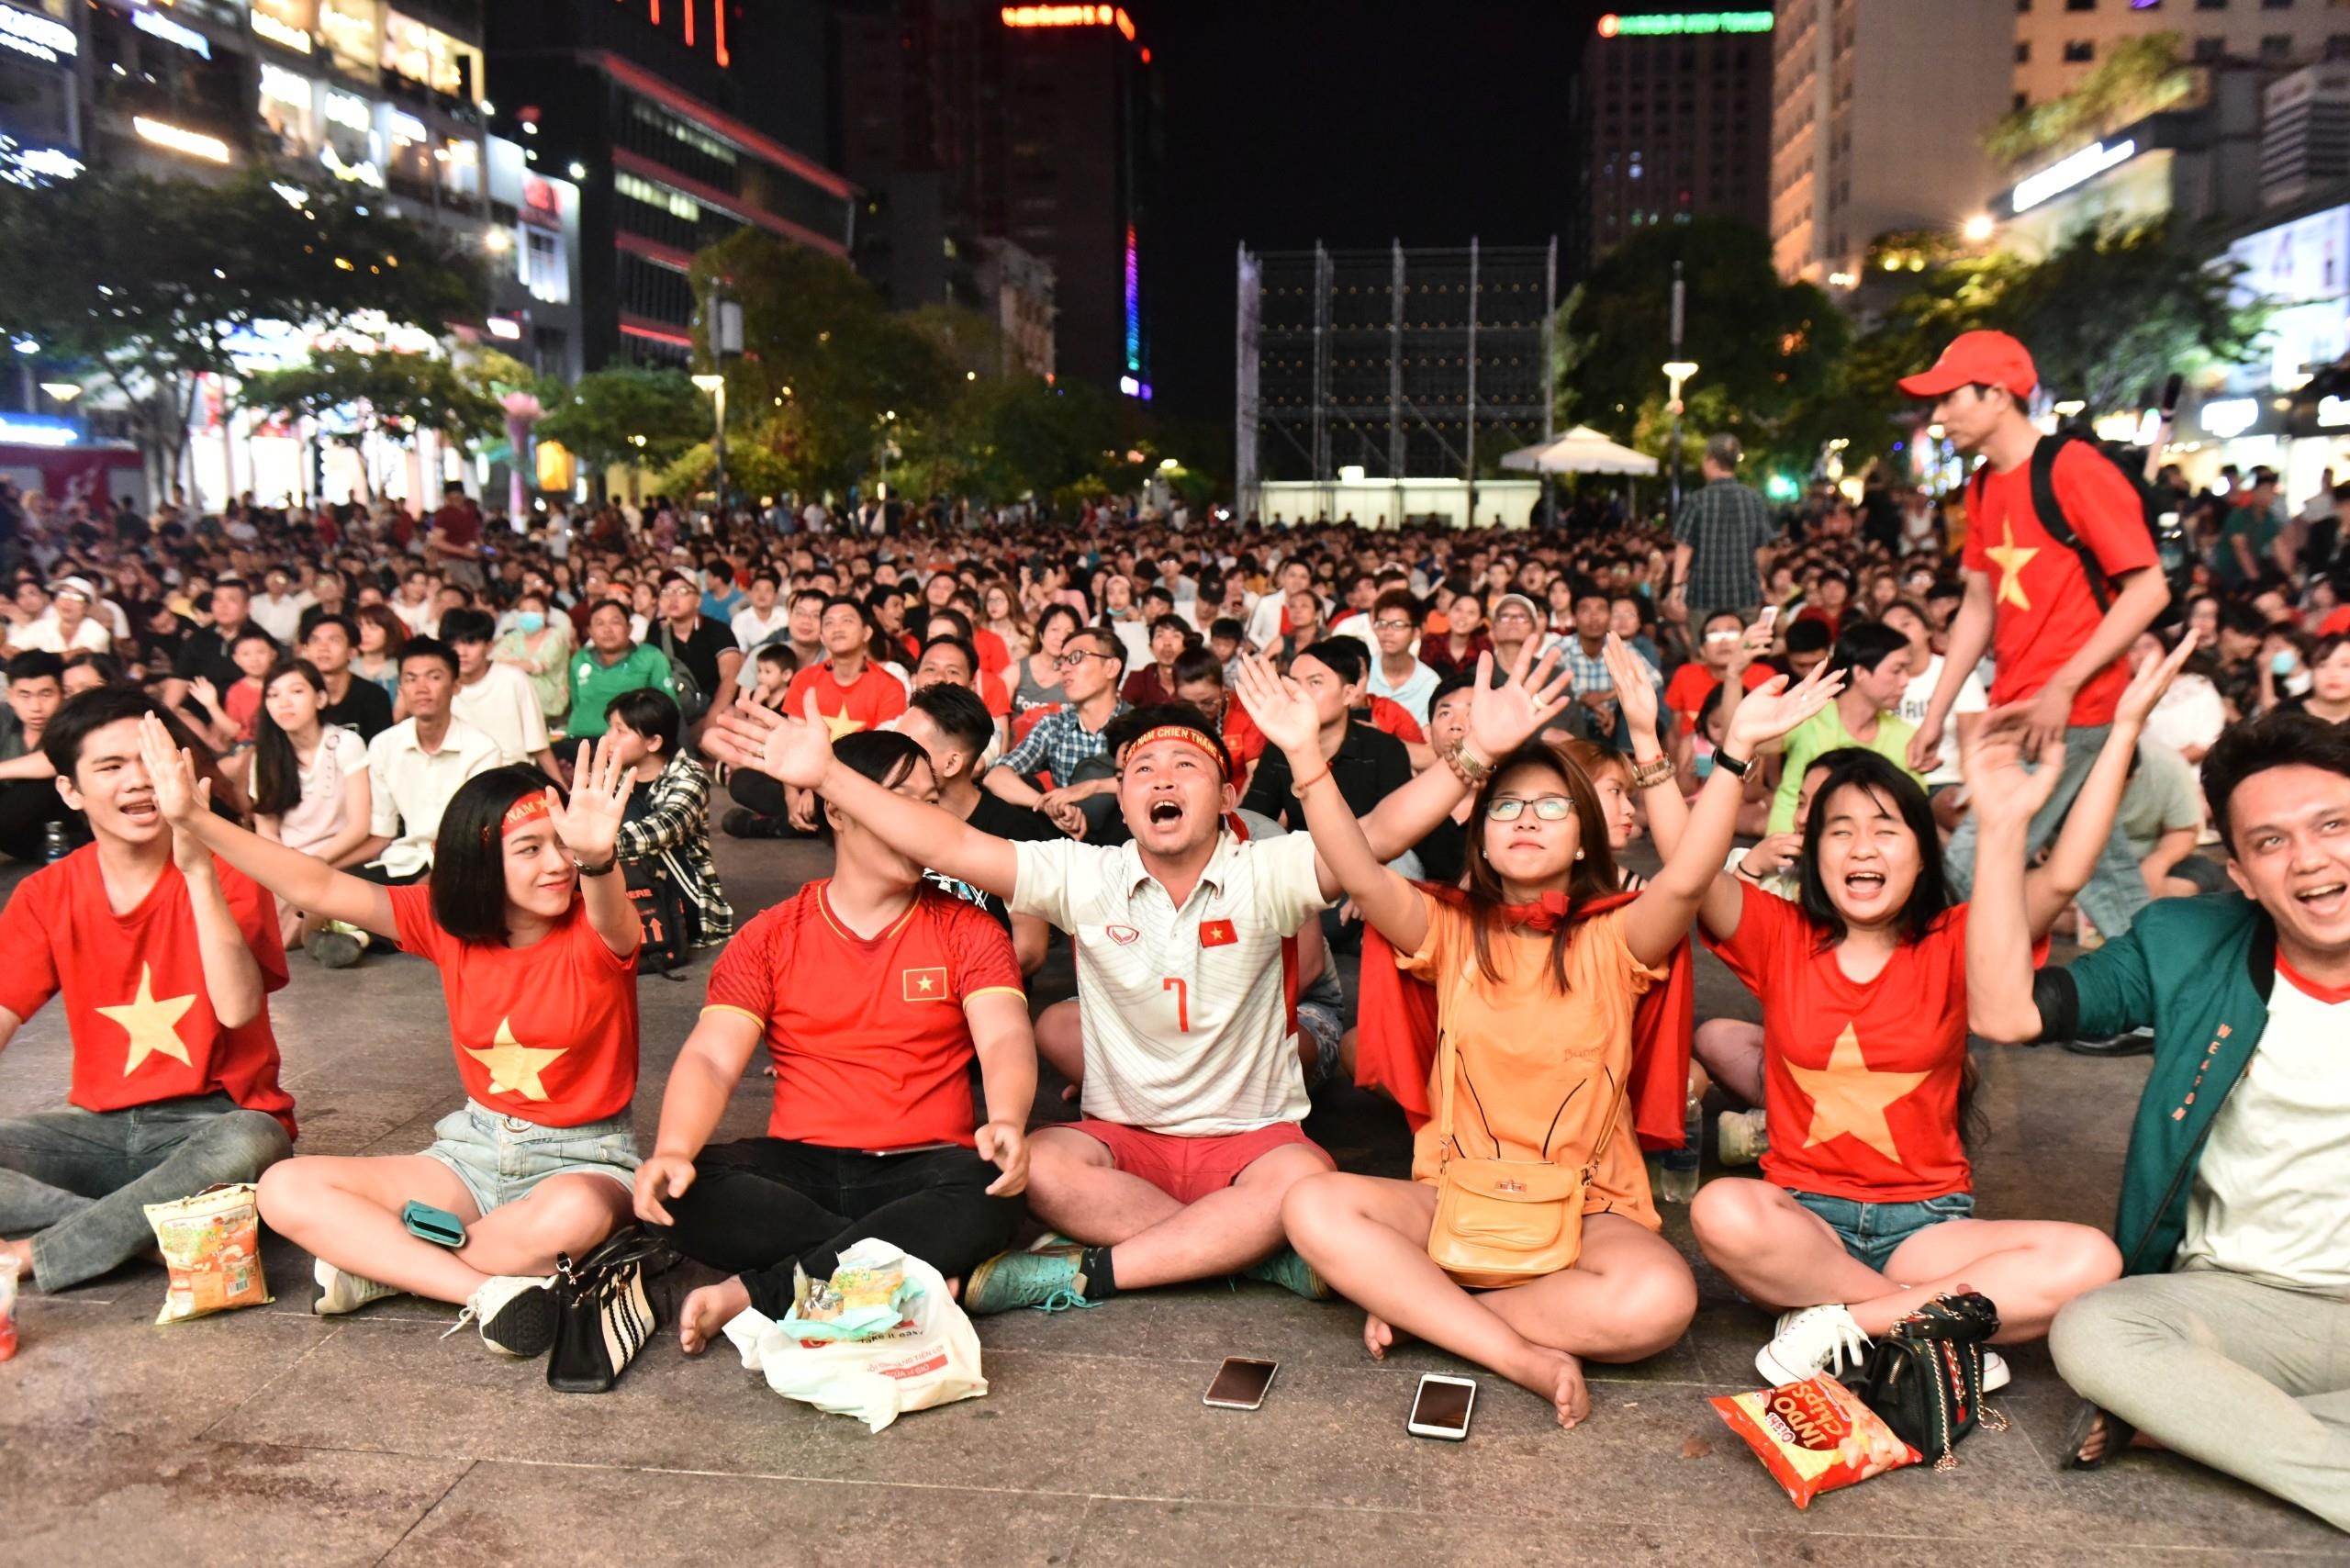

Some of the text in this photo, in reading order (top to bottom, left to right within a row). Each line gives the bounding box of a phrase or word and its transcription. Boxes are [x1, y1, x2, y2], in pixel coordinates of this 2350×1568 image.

[1137, 730, 1155, 747] NAM
[506, 801, 537, 823] NAM
[1163, 978, 1189, 1033] 7
[1766, 1413, 1795, 1444] Oishi
[1774, 1396, 1828, 1448] INDO
